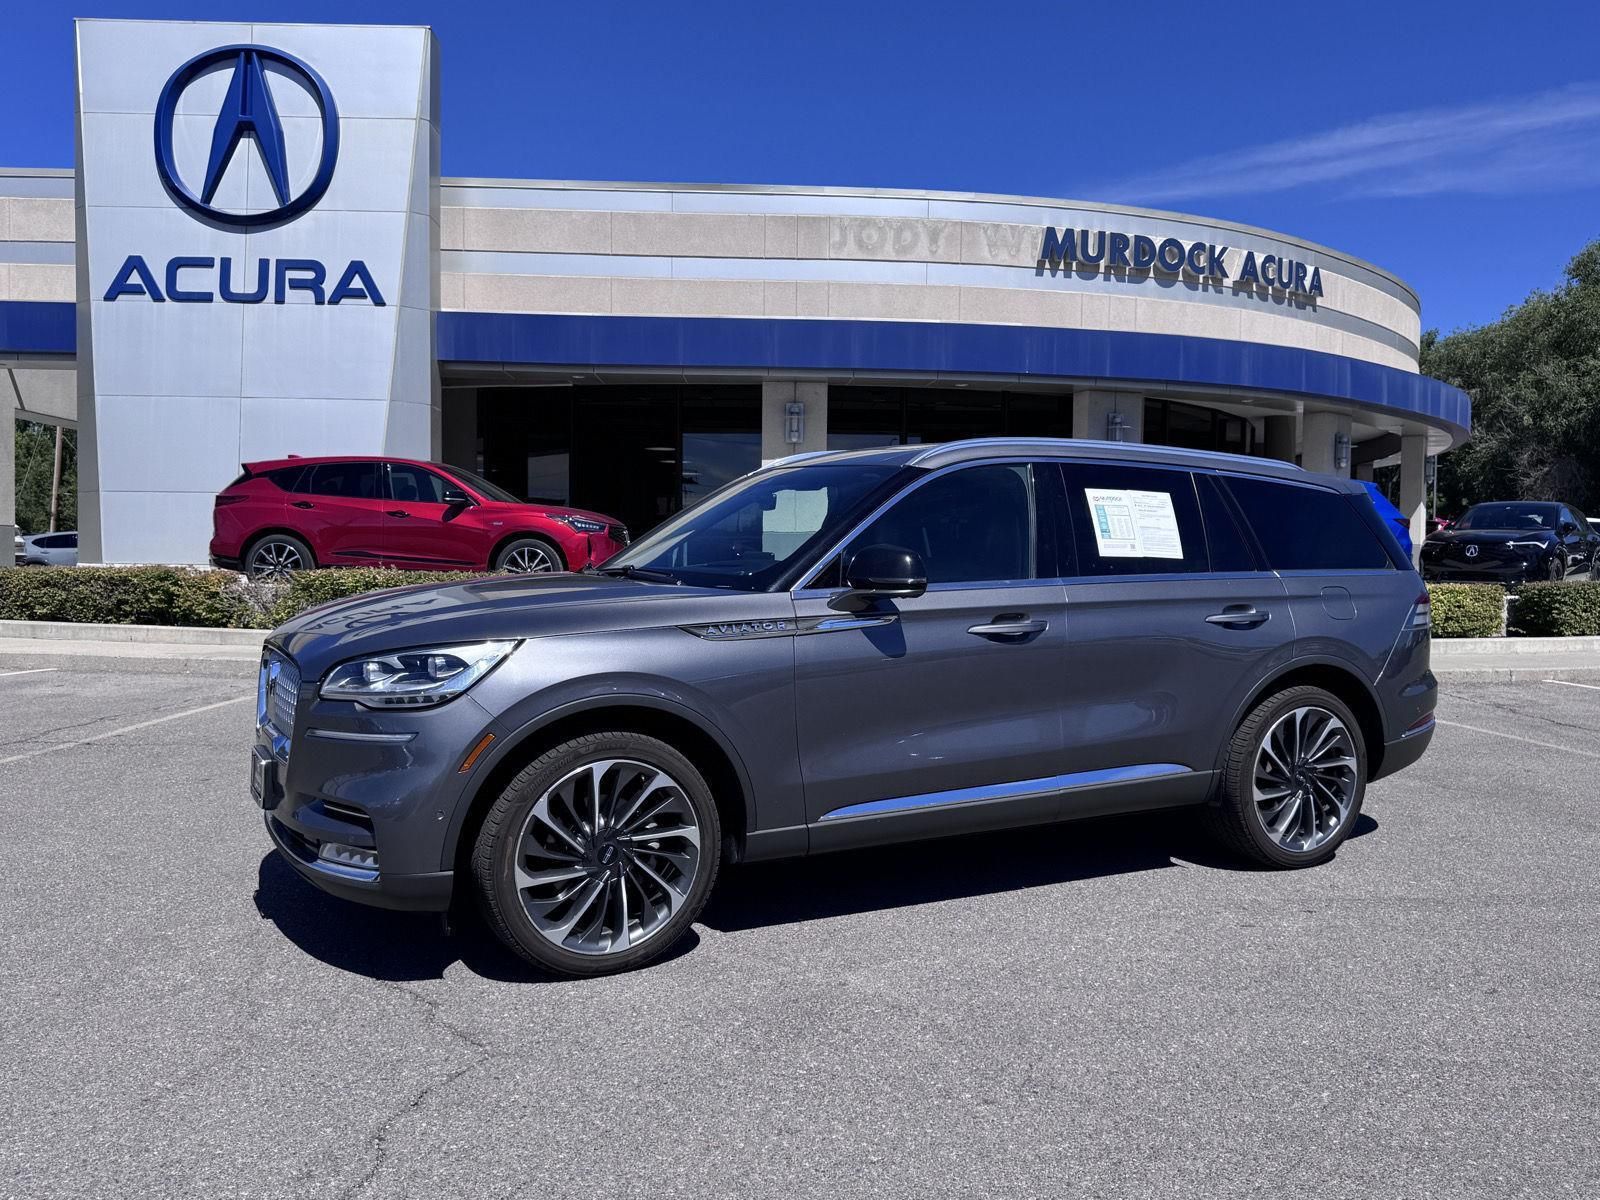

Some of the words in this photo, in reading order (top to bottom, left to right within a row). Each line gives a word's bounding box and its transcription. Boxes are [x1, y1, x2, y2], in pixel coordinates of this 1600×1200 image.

[103, 255, 387, 307] ACURA
[1040, 226, 1229, 279] MURDOCK
[1240, 251, 1324, 298] ACURA
[706, 621, 787, 635] AVIATOR
